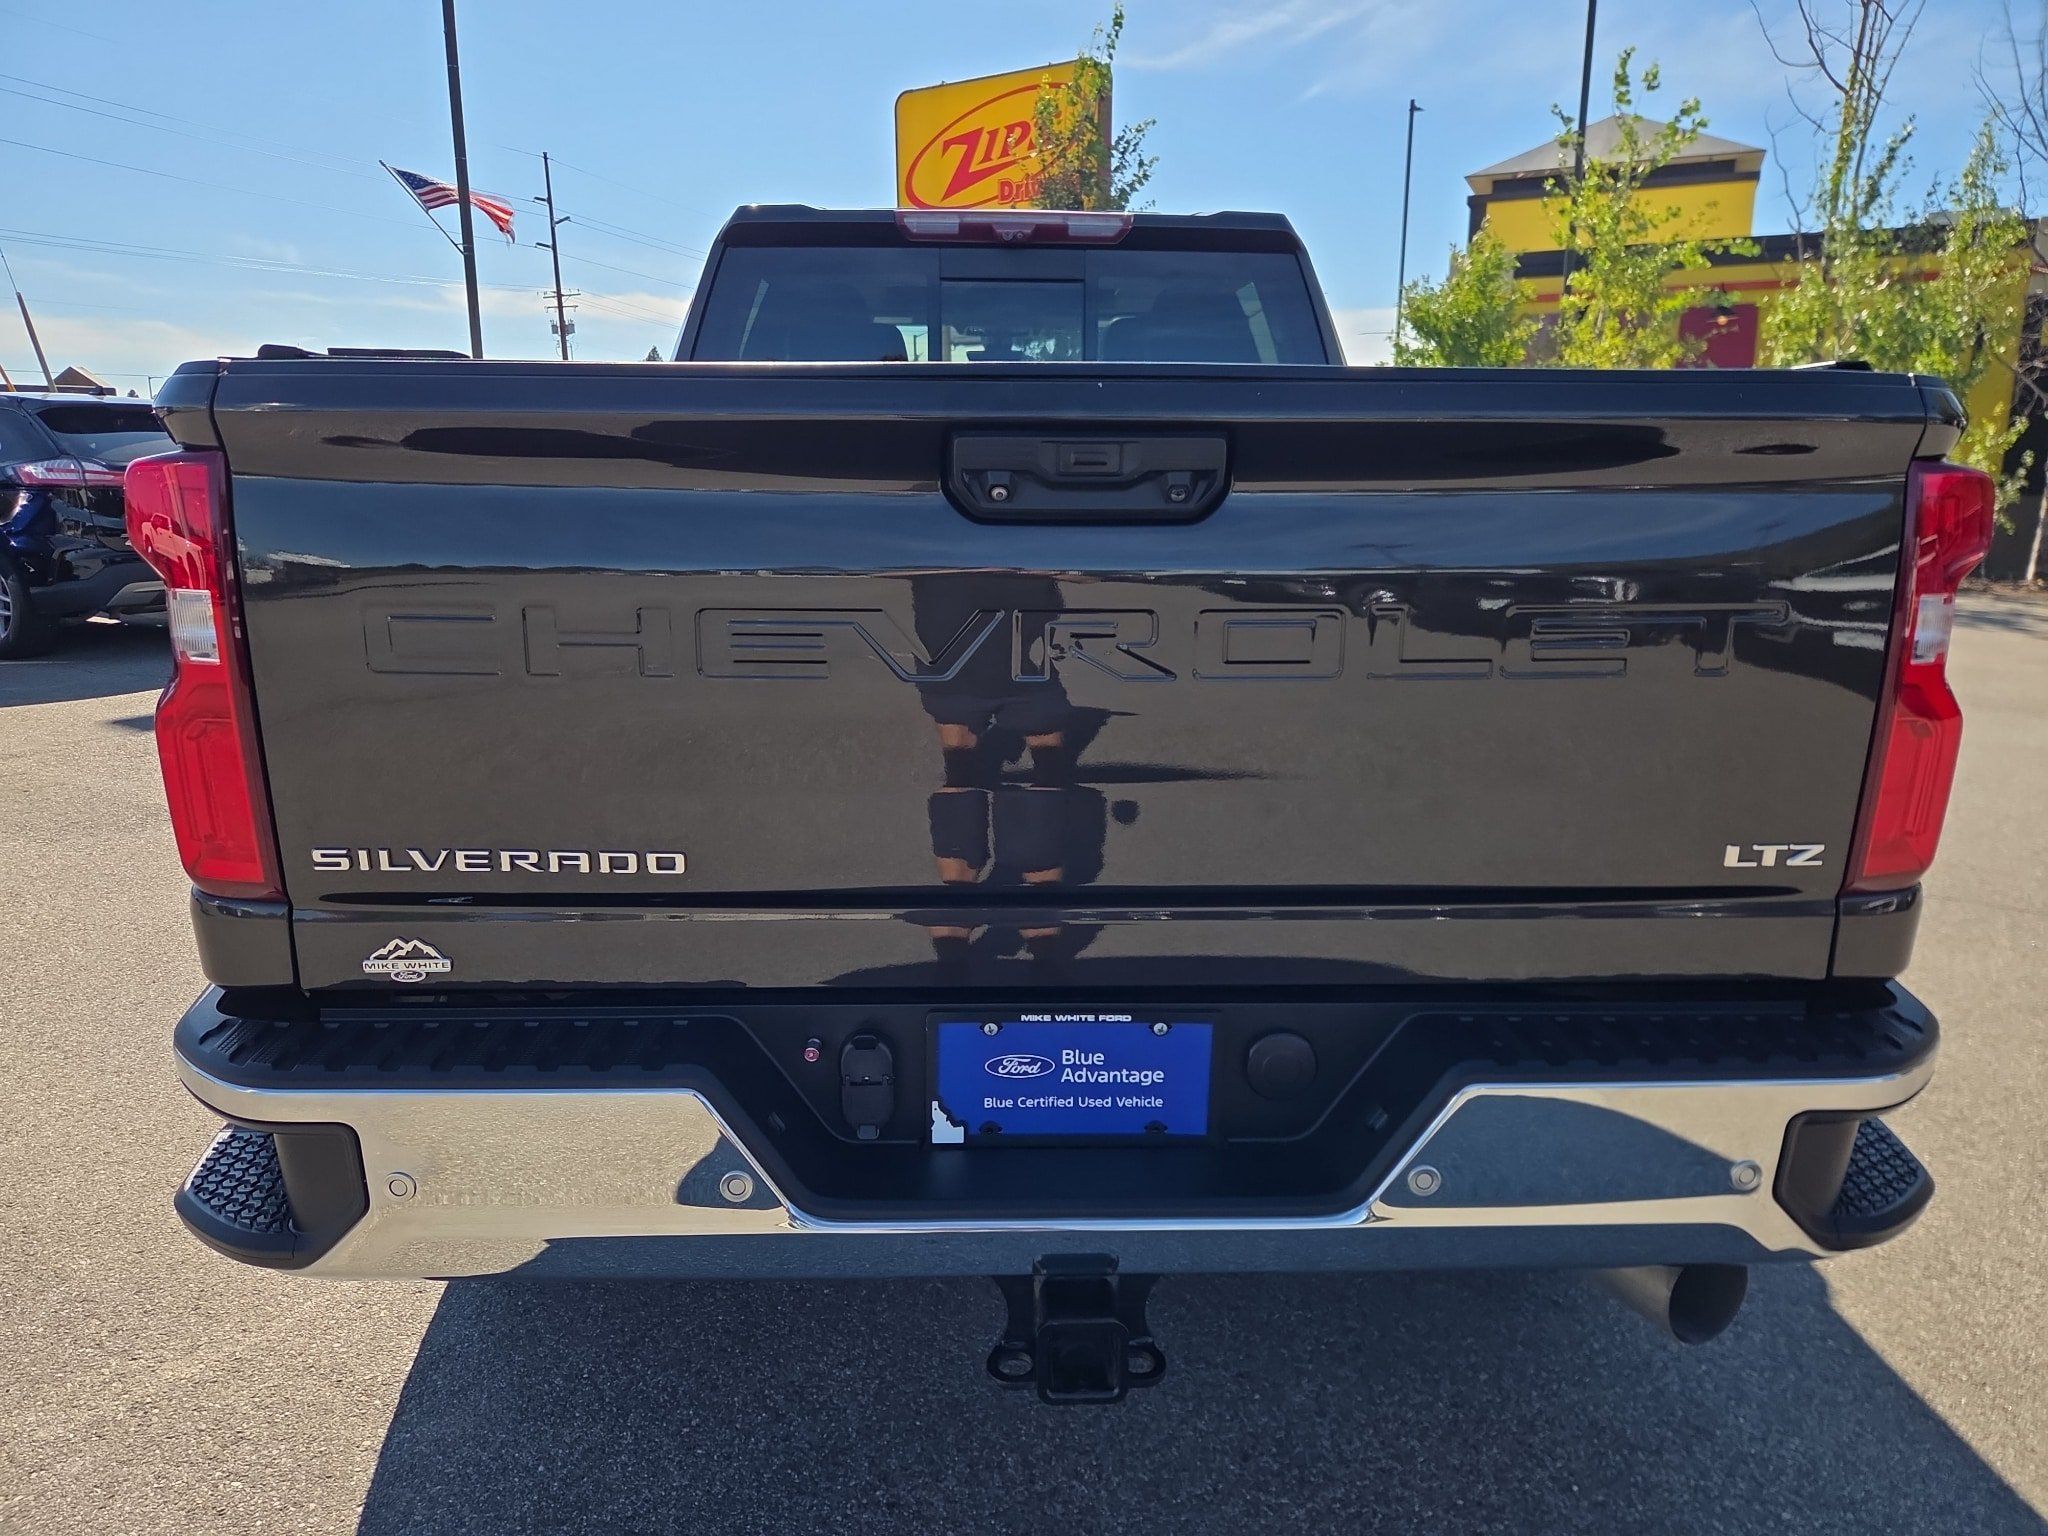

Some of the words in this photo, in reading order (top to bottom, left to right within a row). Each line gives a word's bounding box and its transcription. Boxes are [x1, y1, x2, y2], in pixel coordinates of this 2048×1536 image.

[363, 600, 1791, 684] CHEVROLET
[311, 848, 687, 874] SILVERADO
[1723, 844, 1825, 867] LTZ
[364, 962, 400, 971] MIKE
[403, 961, 450, 970] WHITE
[1020, 1014, 1052, 1022] MIKE
[1054, 1014, 1096, 1022] WHITE
[1098, 1014, 1132, 1022] FORD
[997, 1056, 1041, 1074] Ford
[1062, 1049, 1105, 1065] Blue
[1061, 1067, 1165, 1086] Advantage
[983, 1096, 1013, 1108] Blue
[1017, 1095, 1074, 1108] Certified
[1079, 1095, 1112, 1107] Used
[1116, 1095, 1164, 1107] Vehicle
